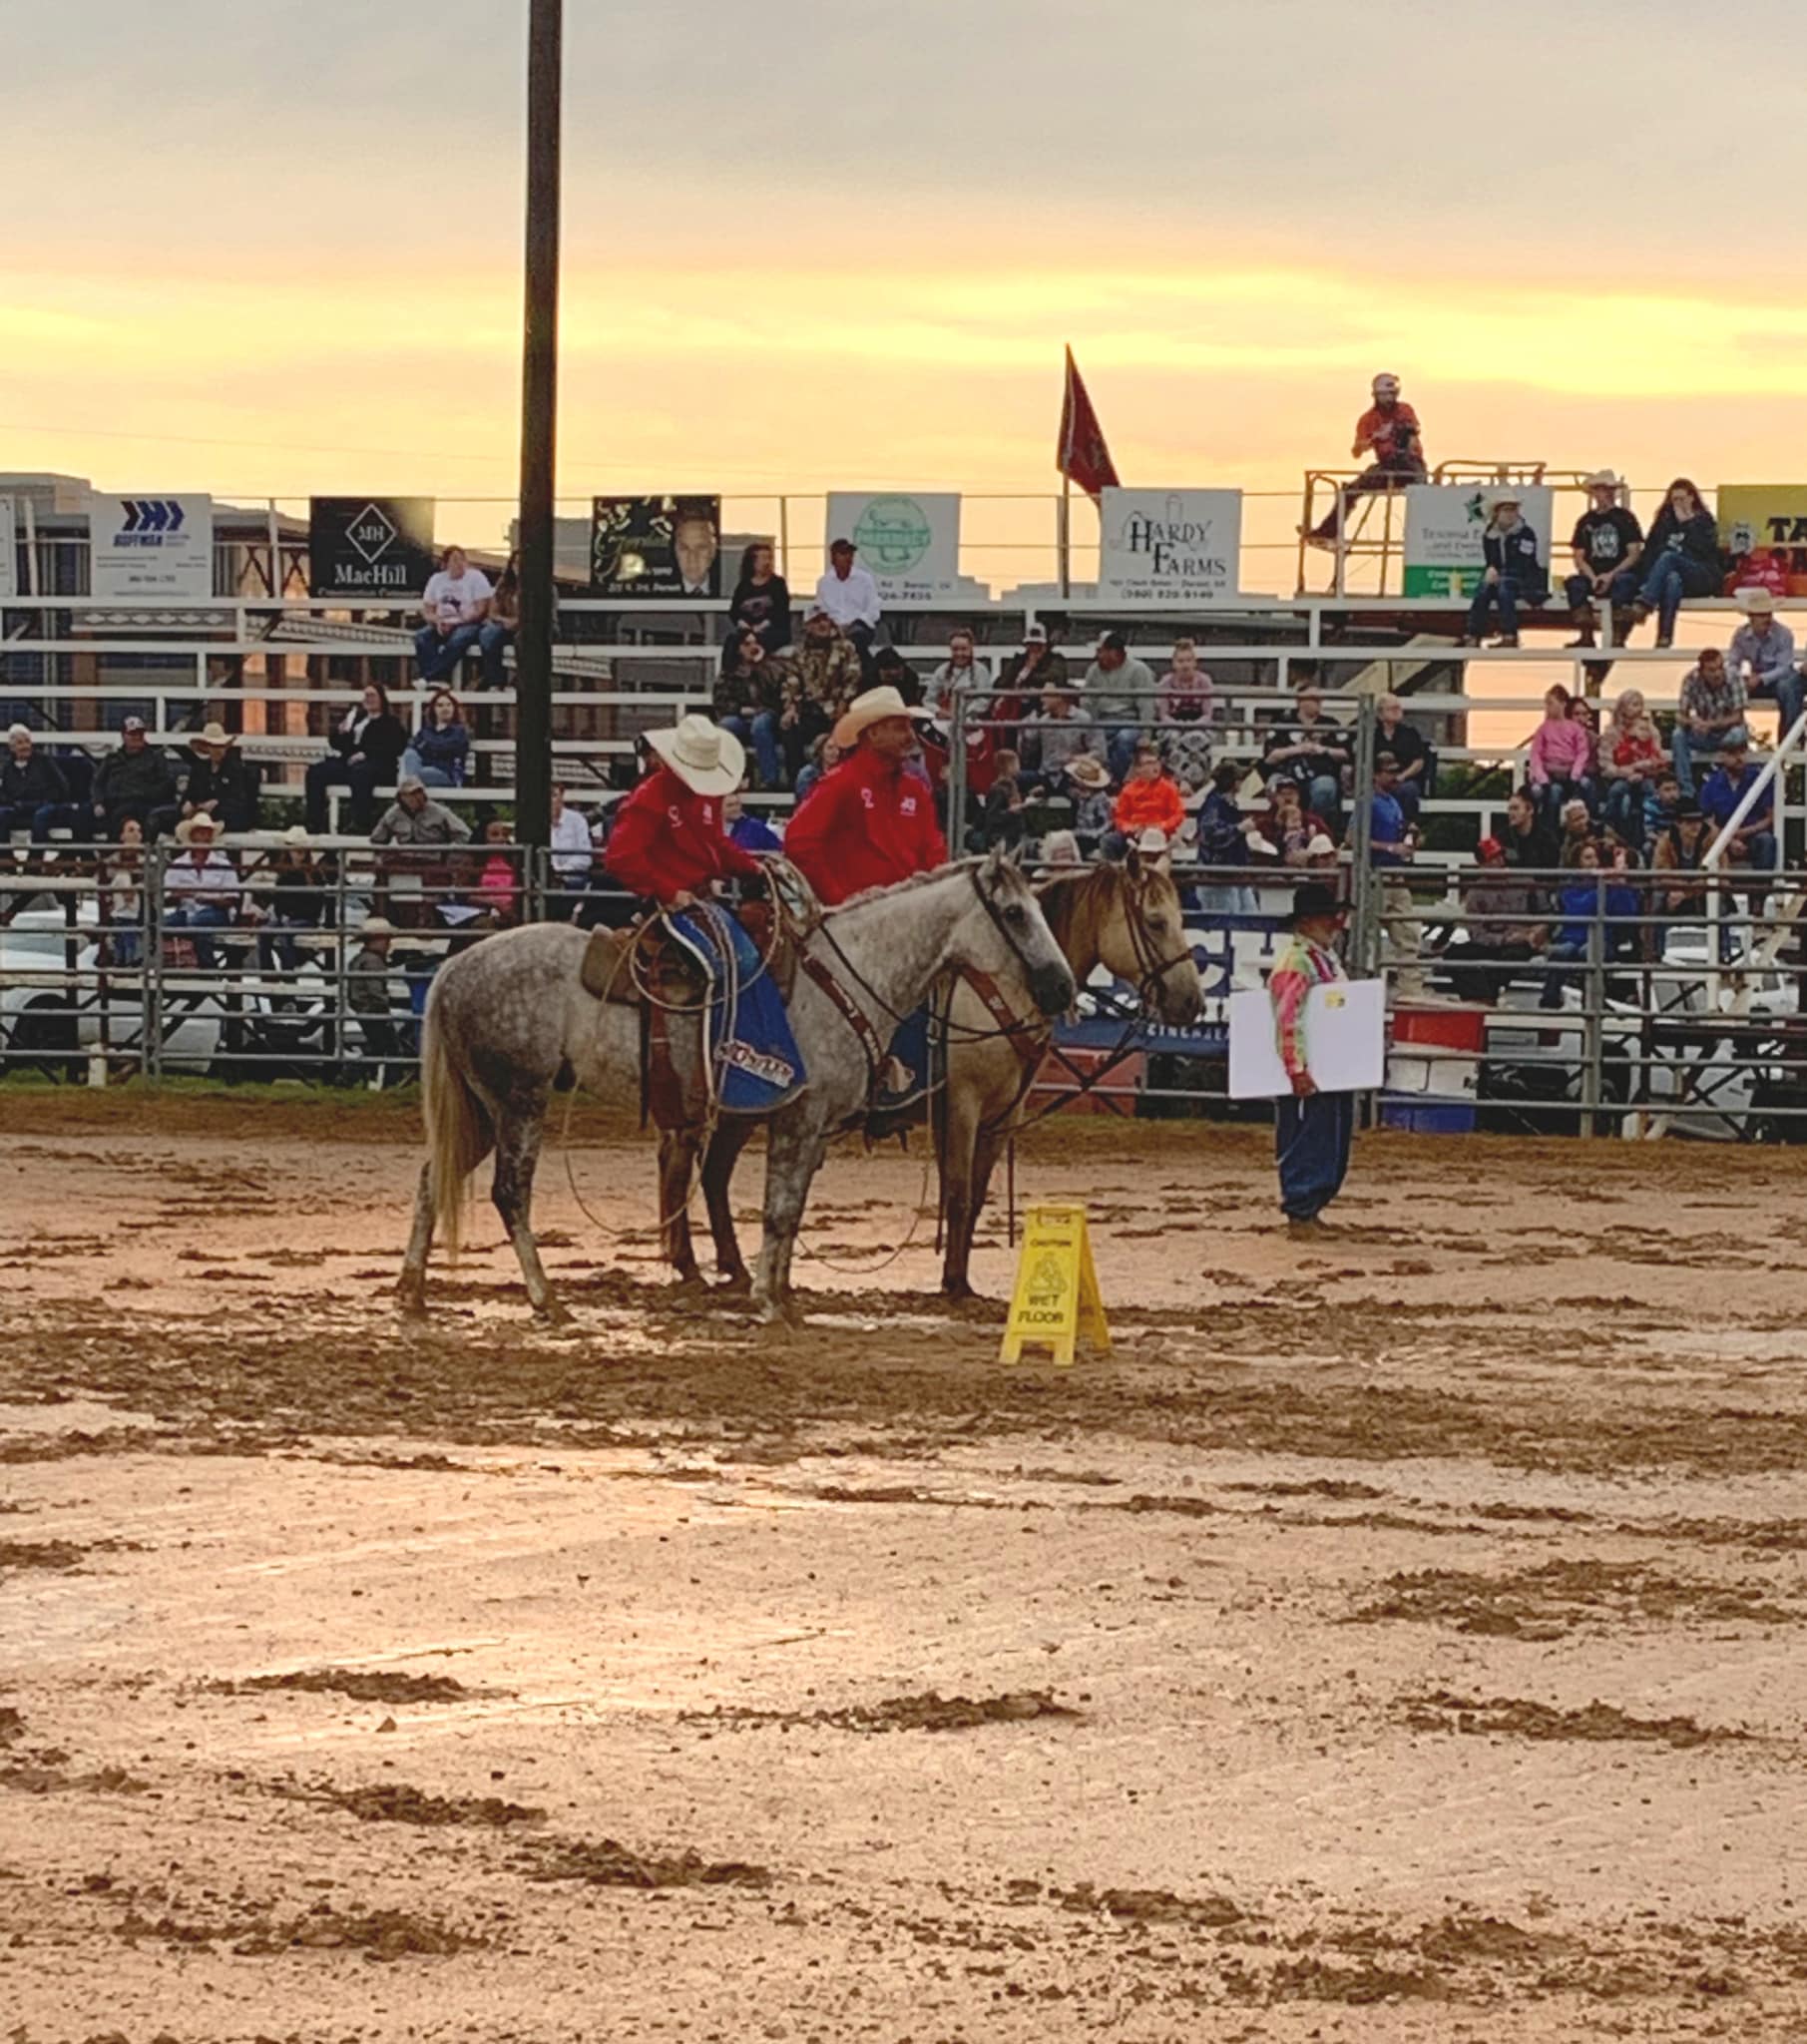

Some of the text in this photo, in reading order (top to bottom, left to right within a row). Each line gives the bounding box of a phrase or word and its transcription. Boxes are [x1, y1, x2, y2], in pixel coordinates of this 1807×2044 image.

[1129, 519, 1212, 553] HARDY
[1152, 542, 1227, 576] FARMS
[334, 564, 407, 585] MacHill
[1029, 1294, 1060, 1305] WET
[1018, 1310, 1064, 1323] FLOOR
